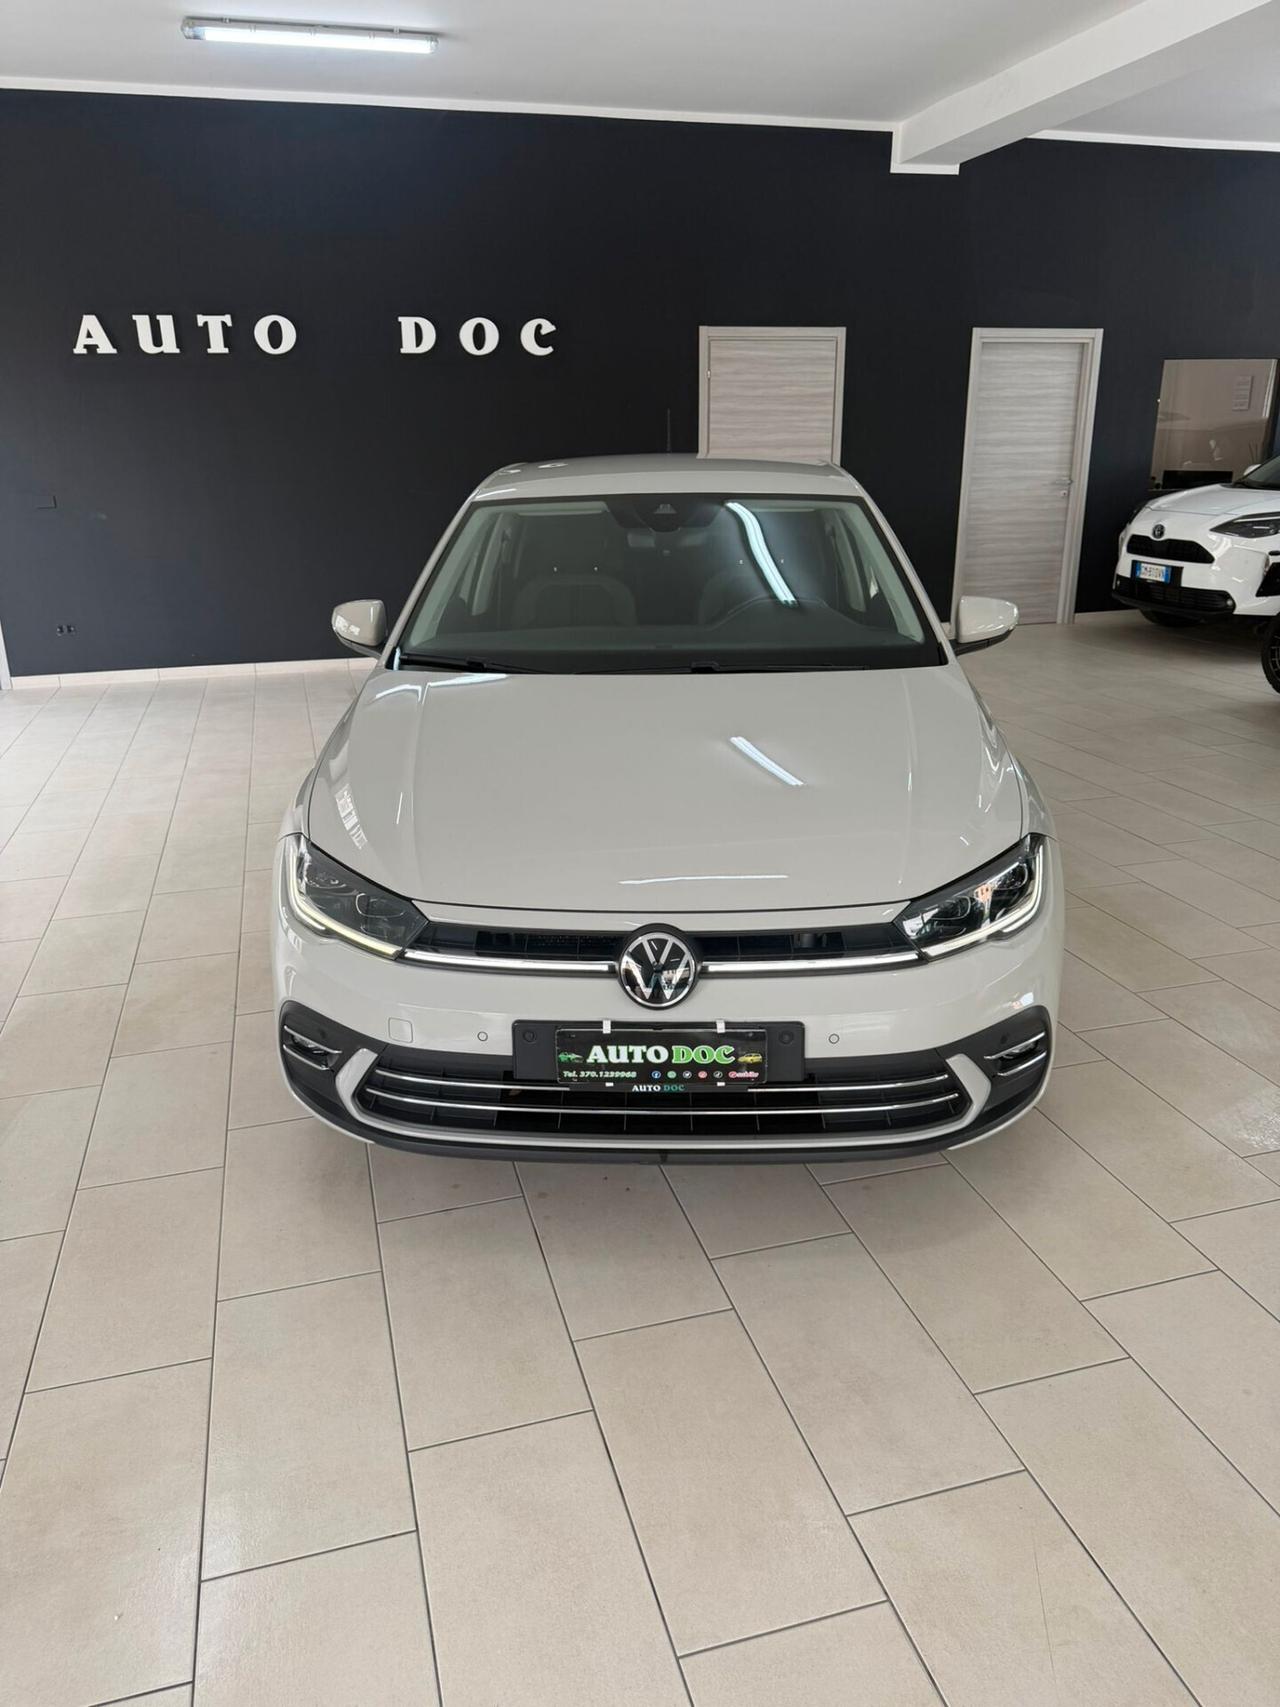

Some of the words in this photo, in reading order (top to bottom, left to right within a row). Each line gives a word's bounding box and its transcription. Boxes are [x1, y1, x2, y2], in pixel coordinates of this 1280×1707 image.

[73, 314, 297, 355] AUTO
[398, 316, 557, 356] DOC
[586, 1045, 669, 1064] AUTO
[671, 1045, 736, 1064] DOC
[563, 1070, 578, 1078] Tel.
[631, 1084, 661, 1092] AUTO
[663, 1084, 686, 1092] DOC
